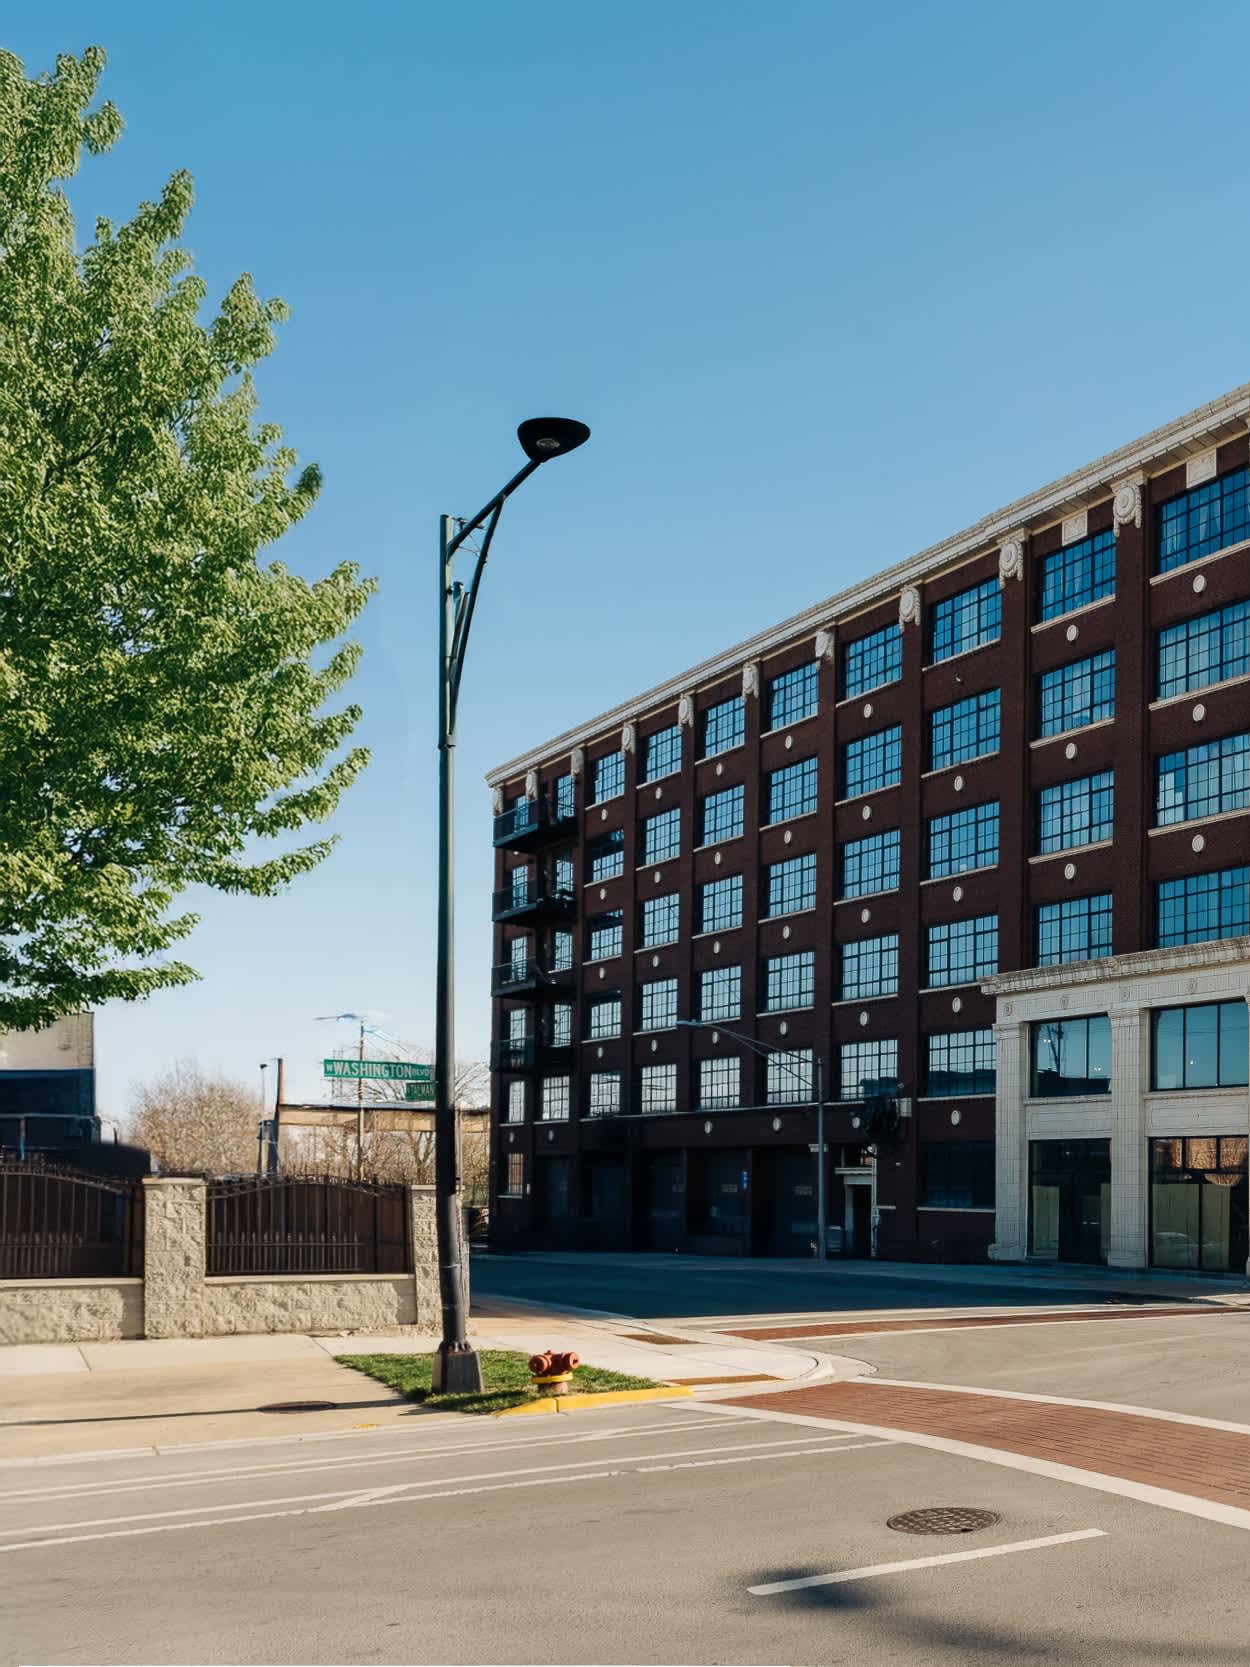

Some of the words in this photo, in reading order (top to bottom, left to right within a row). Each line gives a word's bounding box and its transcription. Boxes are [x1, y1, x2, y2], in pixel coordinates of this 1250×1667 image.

[326, 1063, 333, 1073] W
[333, 1062, 412, 1079] WASHINGTON
[412, 1067, 430, 1077] BLVD
